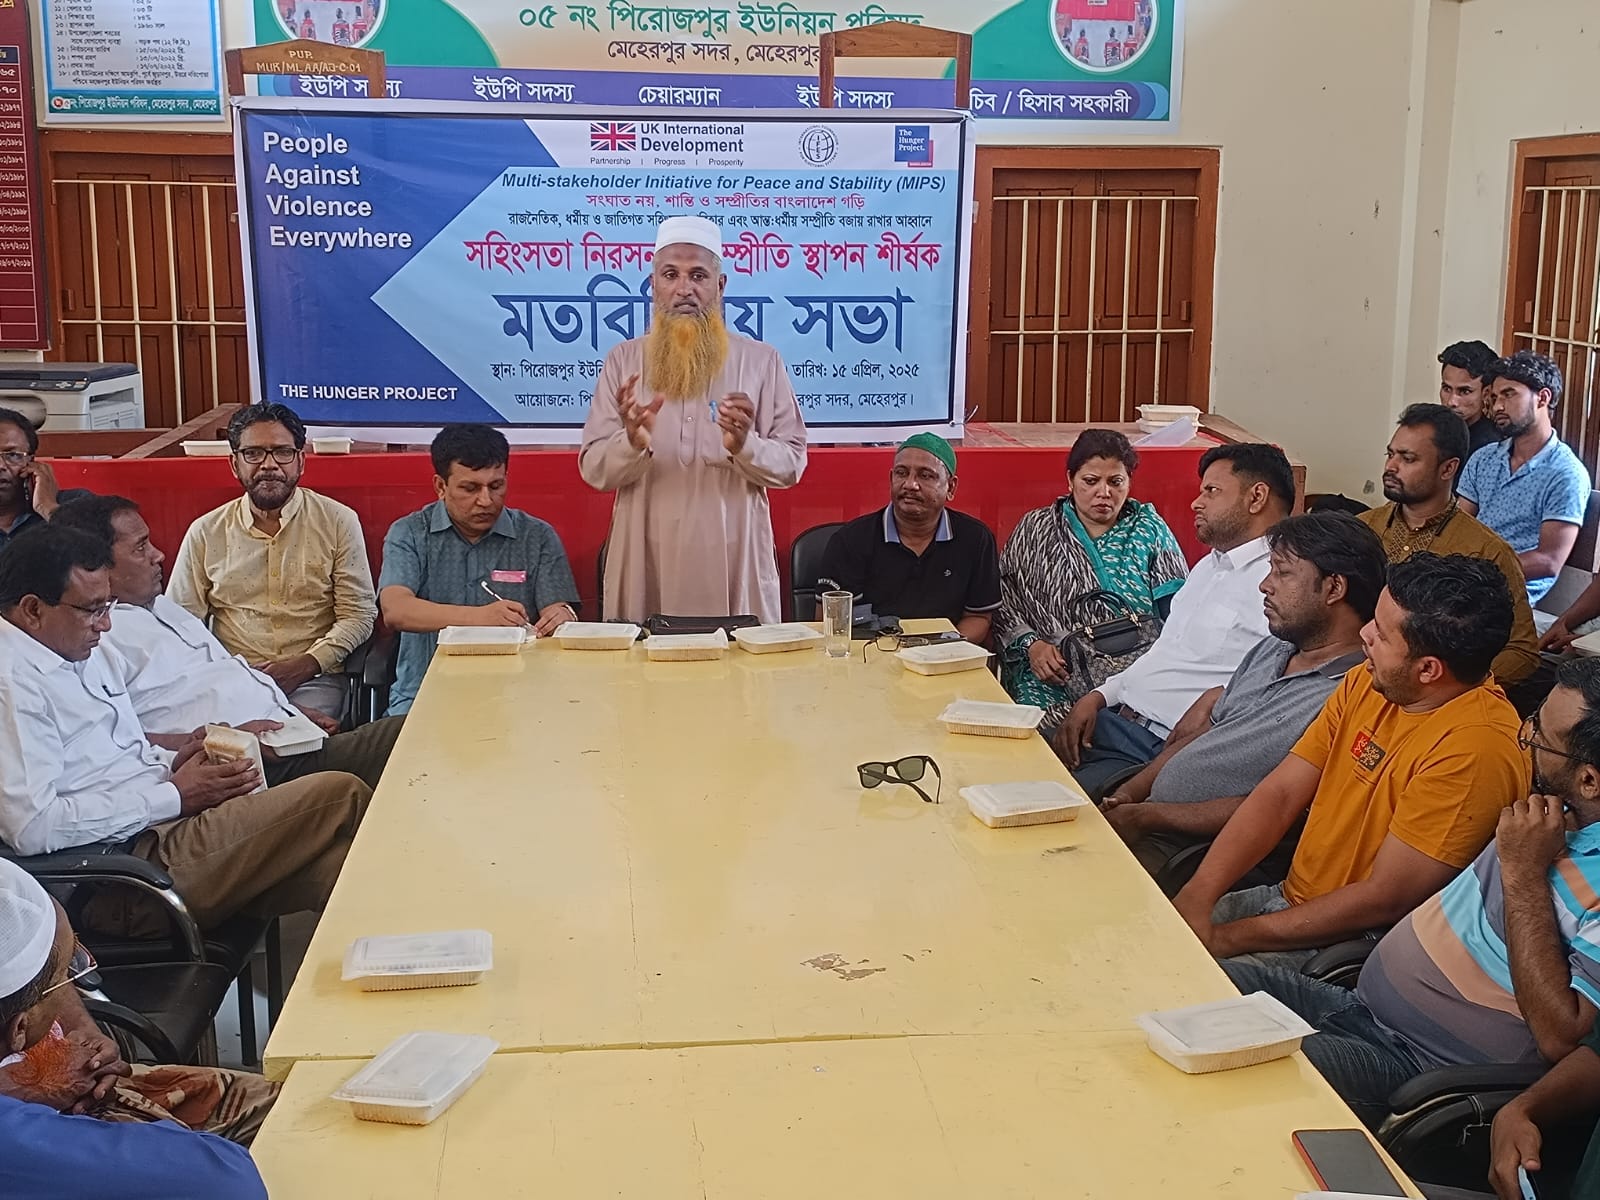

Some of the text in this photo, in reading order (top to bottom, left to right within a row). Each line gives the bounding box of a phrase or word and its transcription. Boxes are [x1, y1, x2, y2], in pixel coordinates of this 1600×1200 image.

[519, 5, 558, 29] ০৫
[567, 5, 600, 32] নং
[606, 0, 731, 40] পিরোজপুর
[737, 1, 837, 36] ইউনিয়ন
[608, 41, 686, 64] মেহেরপুর
[298, 75, 350, 97] ইউপি
[472, 76, 576, 103] ইউপি সদস্য
[638, 85, 722, 106] চেয়ারম্যান
[847, 90, 895, 109] সদস্য
[1016, 88, 1065, 113] হিসাব
[1069, 88, 1132, 115] সহকারী
[641, 123, 744, 135] UK International
[263, 131, 348, 155] People
[641, 137, 744, 155] Development
[898, 137, 925, 145] Hunger
[590, 157, 744, 167] Partnership Progress Prosperity
[265, 163, 360, 188] Against
[502, 173, 946, 192] Multi-stakeholder Initiative for Peace and Stability (MIPS)
[266, 194, 372, 217] Violence
[586, 194, 631, 207] সংঘাত
[664, 192, 695, 208] শান্তি
[699, 196, 710, 207] ও
[714, 192, 769, 209] সম্প্রীতির
[774, 194, 836, 209] বাংলাদেশ
[841, 193, 866, 210] গড়ি
[508, 210, 562, 227] রাজনৈতিক,
[565, 209, 589, 226] ধর্মীয়
[593, 214, 601, 225] ও
[604, 211, 643, 226] জাতিগত
[727, 214, 748, 228] এবং
[801, 212, 835, 228] সম্প্রীতি
[839, 214, 864, 227] বজায়
[867, 214, 892, 228] রাখার
[269, 225, 412, 252] Everywhere
[463, 230, 573, 275] সহিংসতা
[721, 232, 794, 277] ম্প্রীতি
[799, 240, 869, 281] স্থাপন
[874, 231, 942, 273] শীর্ষক
[784, 286, 916, 353] সভা
[490, 361, 516, 381] স্থান:
[519, 359, 575, 382] পিরোজপুর
[791, 359, 828, 379] তারিখ:
[832, 364, 847, 378] ১৫
[851, 359, 885, 380] এপ্রিল,
[888, 363, 920, 378] ২০২৫
[279, 384, 457, 401] THE HUNGER PROJECT
[514, 393, 574, 407] আয়োজনে:
[825, 393, 854, 409] সদর,
